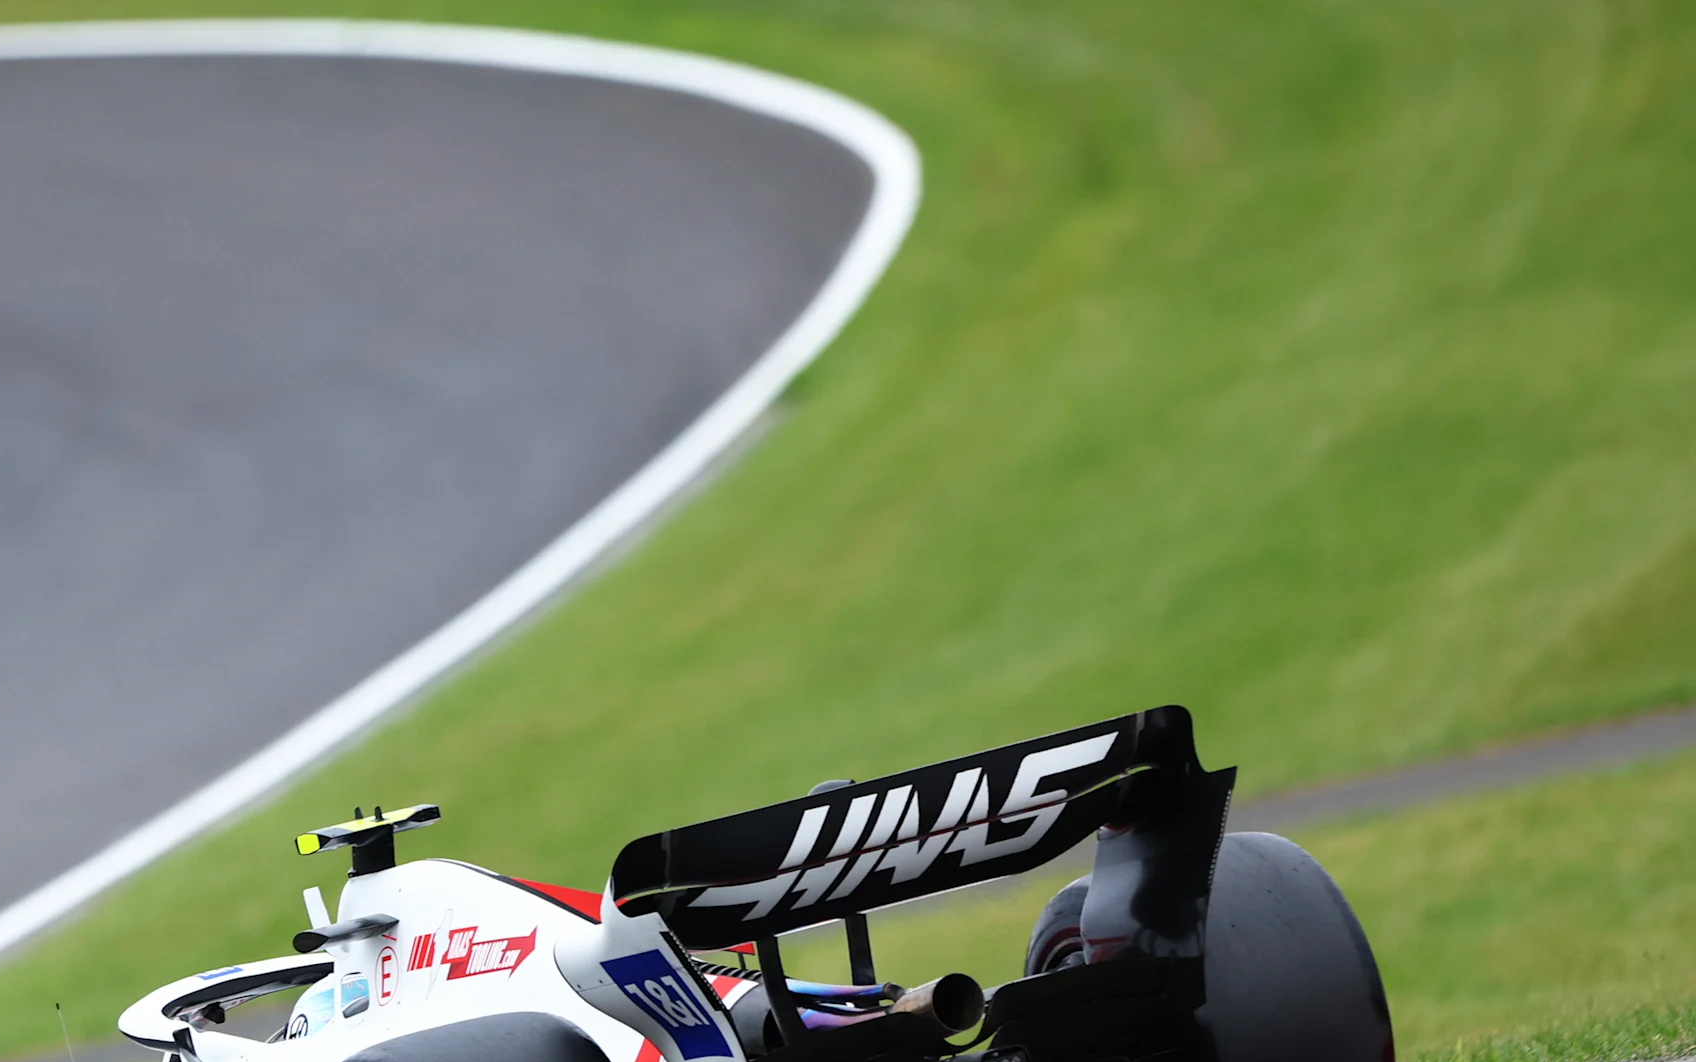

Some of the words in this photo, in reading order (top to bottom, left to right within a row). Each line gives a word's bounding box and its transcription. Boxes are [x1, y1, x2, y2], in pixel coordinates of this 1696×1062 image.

[689, 731, 1119, 921] HAAS
[381, 955, 392, 998] E
[624, 975, 710, 1028] 1&1
